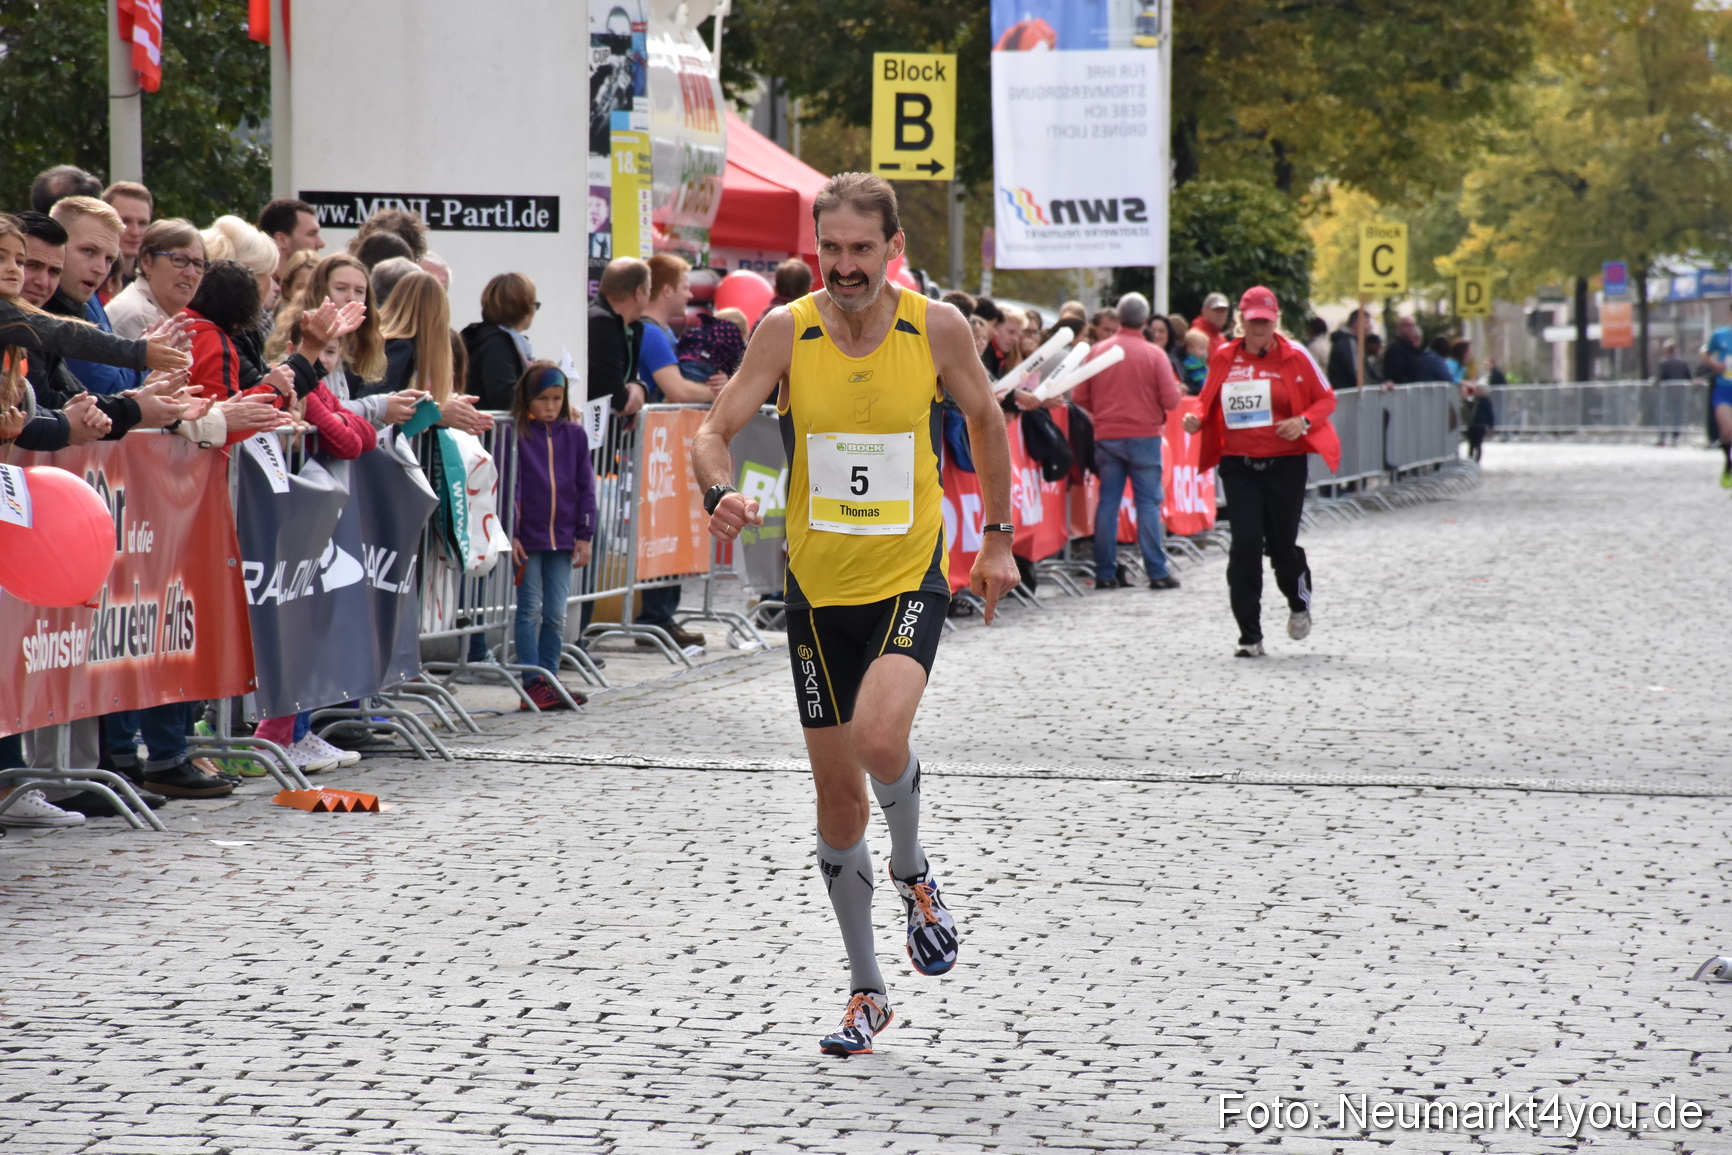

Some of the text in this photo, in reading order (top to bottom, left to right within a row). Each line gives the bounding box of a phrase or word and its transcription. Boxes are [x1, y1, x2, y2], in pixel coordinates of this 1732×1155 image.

[884, 59, 946, 81] Block
[894, 92, 934, 151] B
[1366, 227, 1401, 238] Block
[1371, 244, 1394, 276] C
[1465, 282, 1482, 305] D
[1228, 395, 1263, 411] 2557
[594, 404, 602, 432] swn
[255, 436, 280, 469] swn
[847, 443, 884, 452] BOCK
[850, 465, 869, 496] 5
[839, 504, 880, 518] Thomas
[161, 580, 195, 655] Hits
[898, 600, 924, 638] SKINS
[801, 660, 823, 719] SKINS
